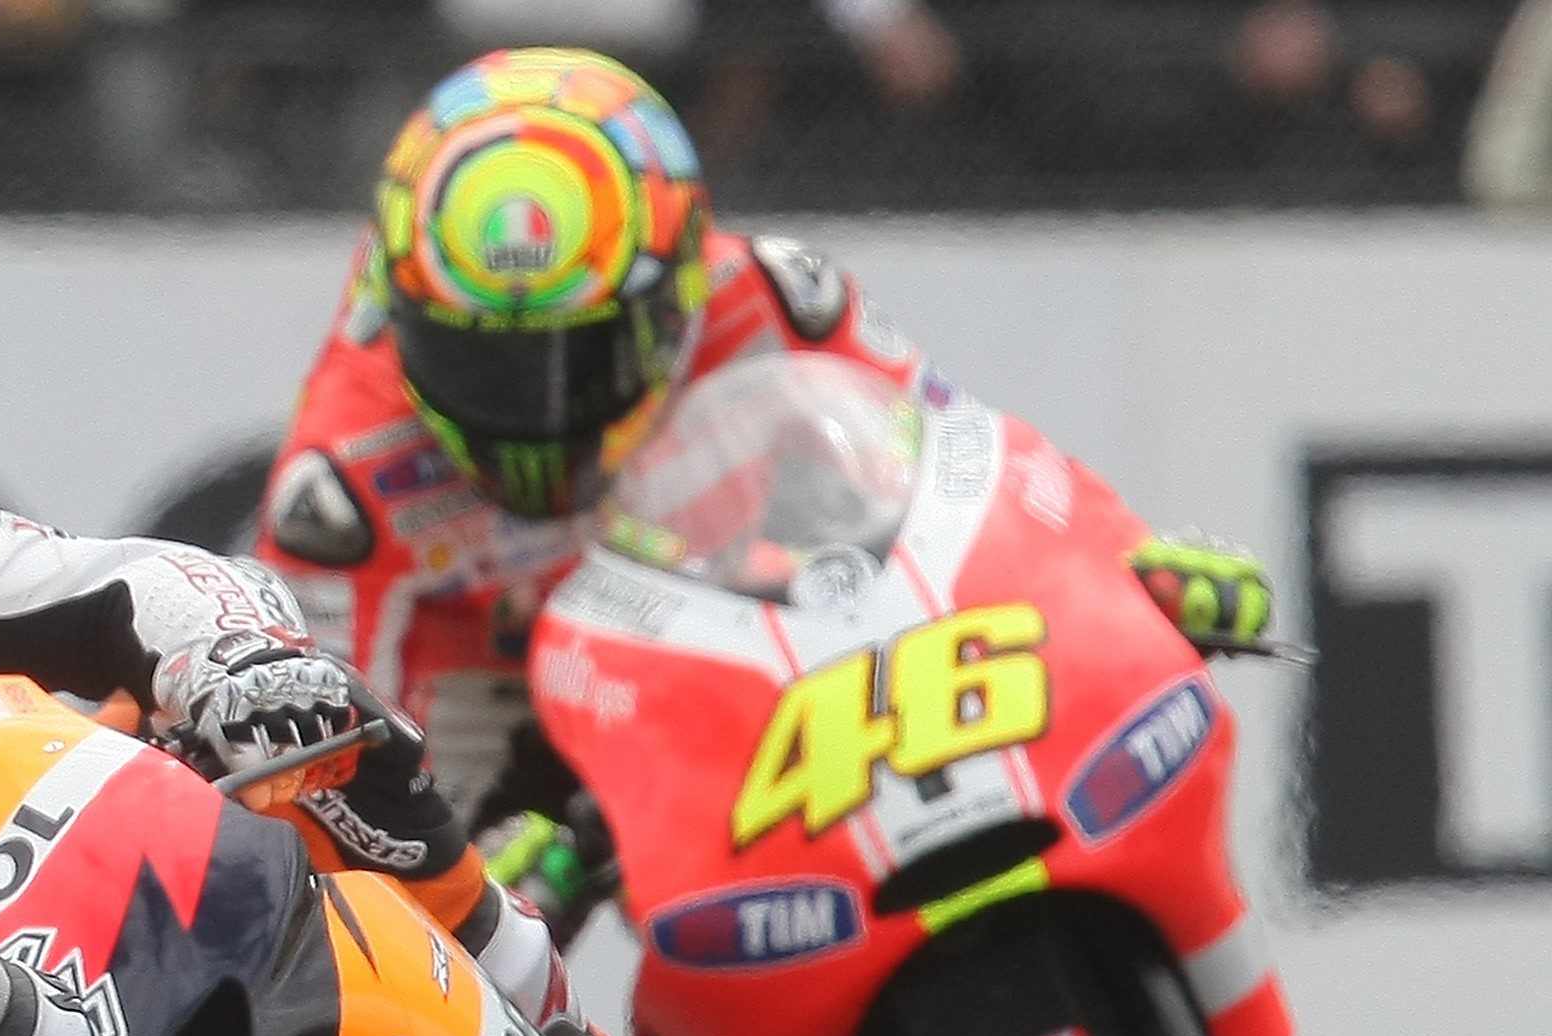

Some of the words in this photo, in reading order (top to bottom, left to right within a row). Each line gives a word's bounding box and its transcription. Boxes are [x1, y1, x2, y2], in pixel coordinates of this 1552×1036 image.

[730, 602, 1048, 853] 46
[1127, 687, 1210, 782] TIM
[738, 890, 838, 957] TIM
